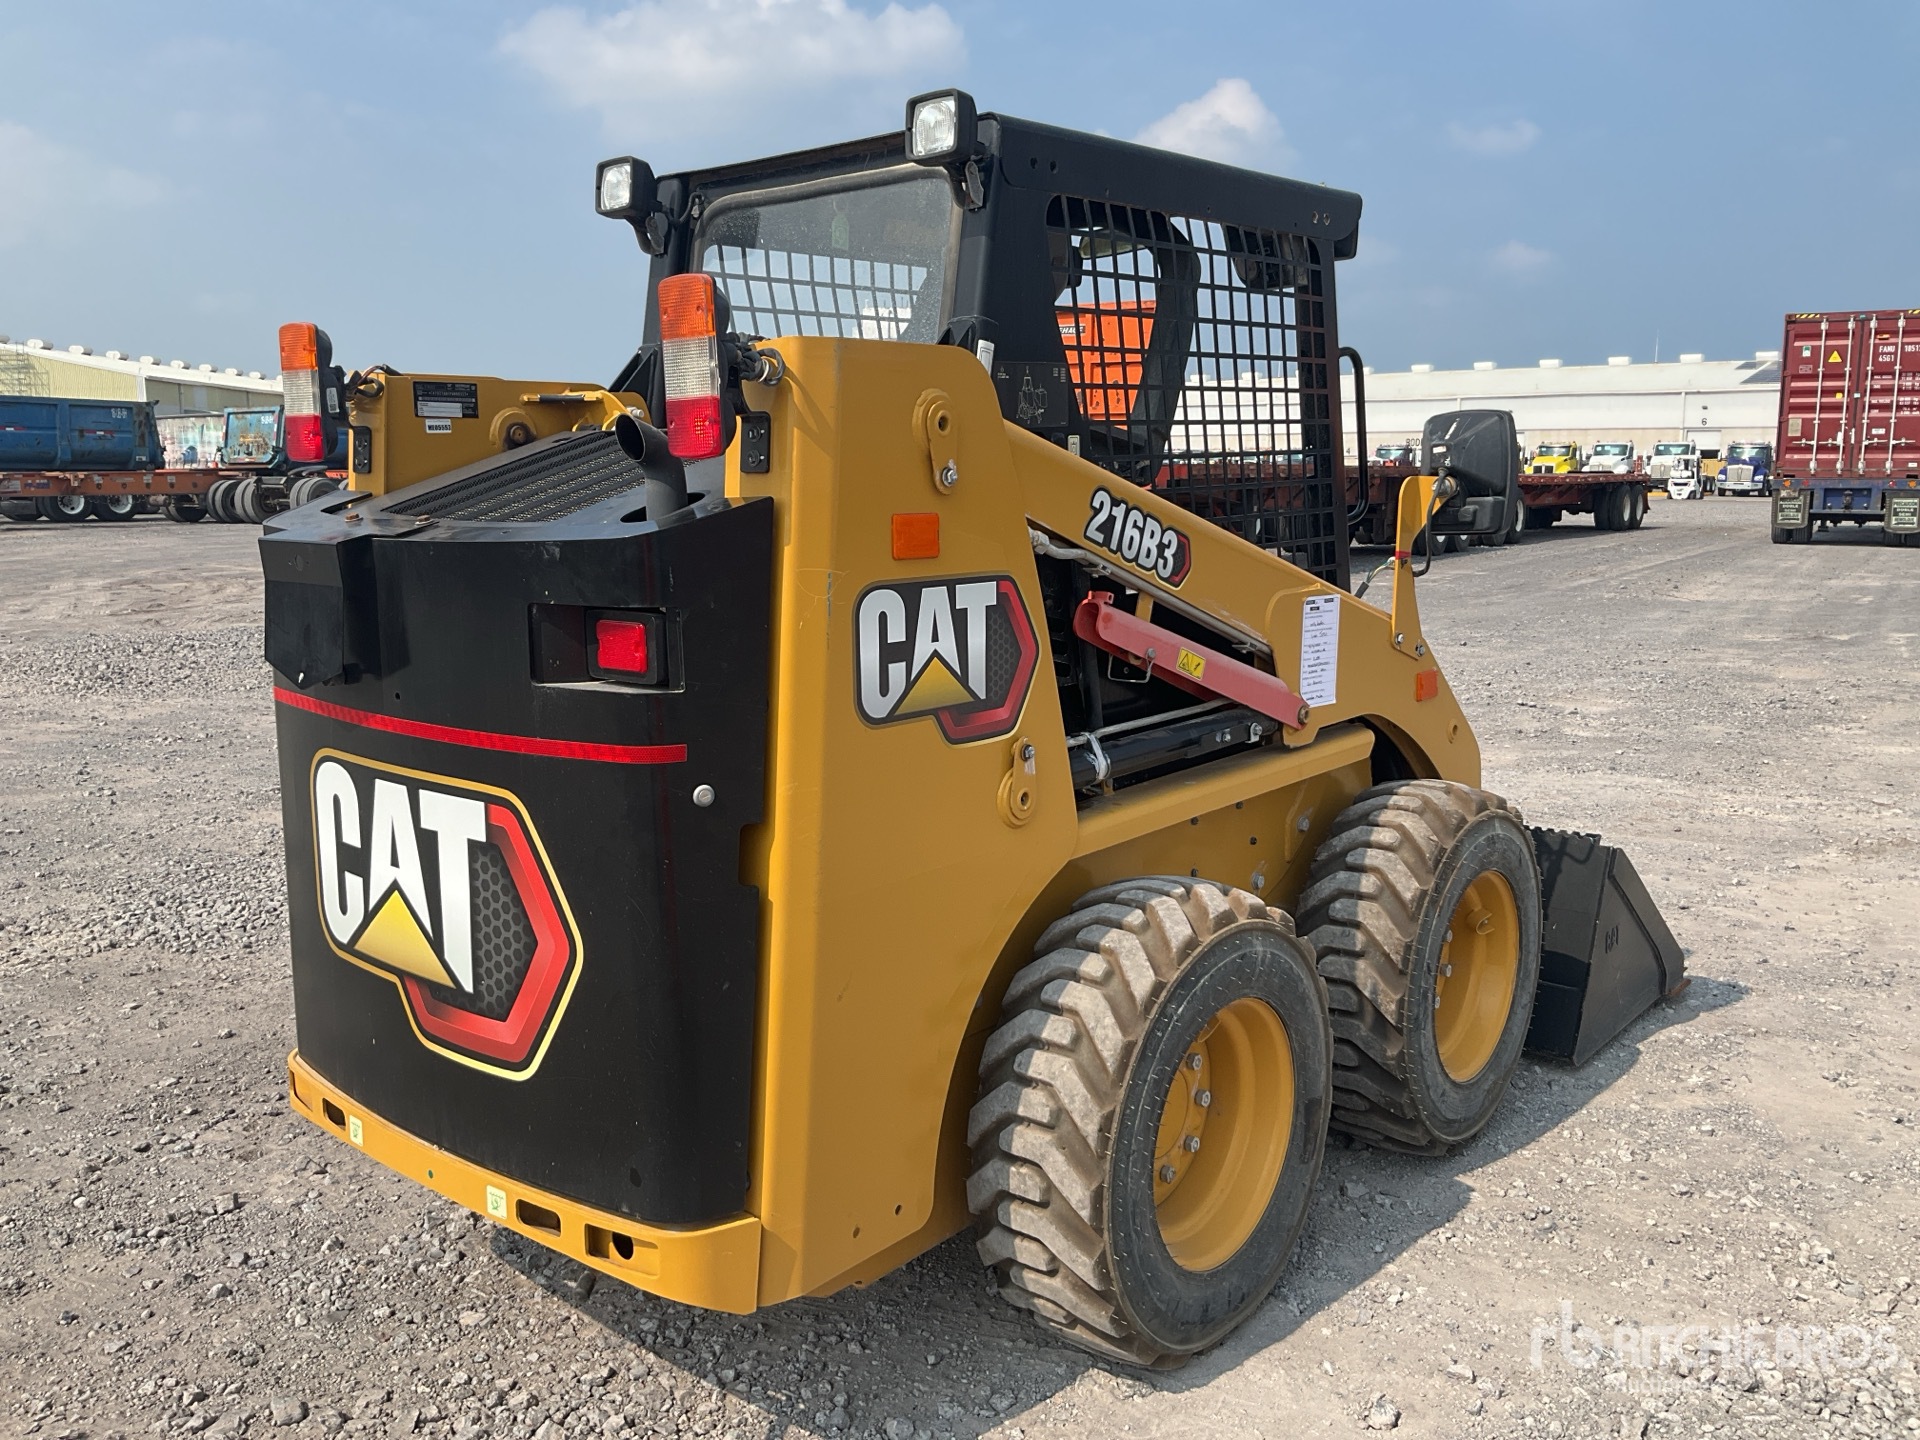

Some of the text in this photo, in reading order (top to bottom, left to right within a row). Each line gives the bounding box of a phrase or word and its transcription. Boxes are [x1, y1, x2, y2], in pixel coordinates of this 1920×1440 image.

[1405, 438, 1422, 447] BOD
[1701, 417, 1708, 427] 6
[1085, 490, 1179, 579] 216B3
[859, 581, 997, 719] CAT
[316, 761, 487, 994] CAT
